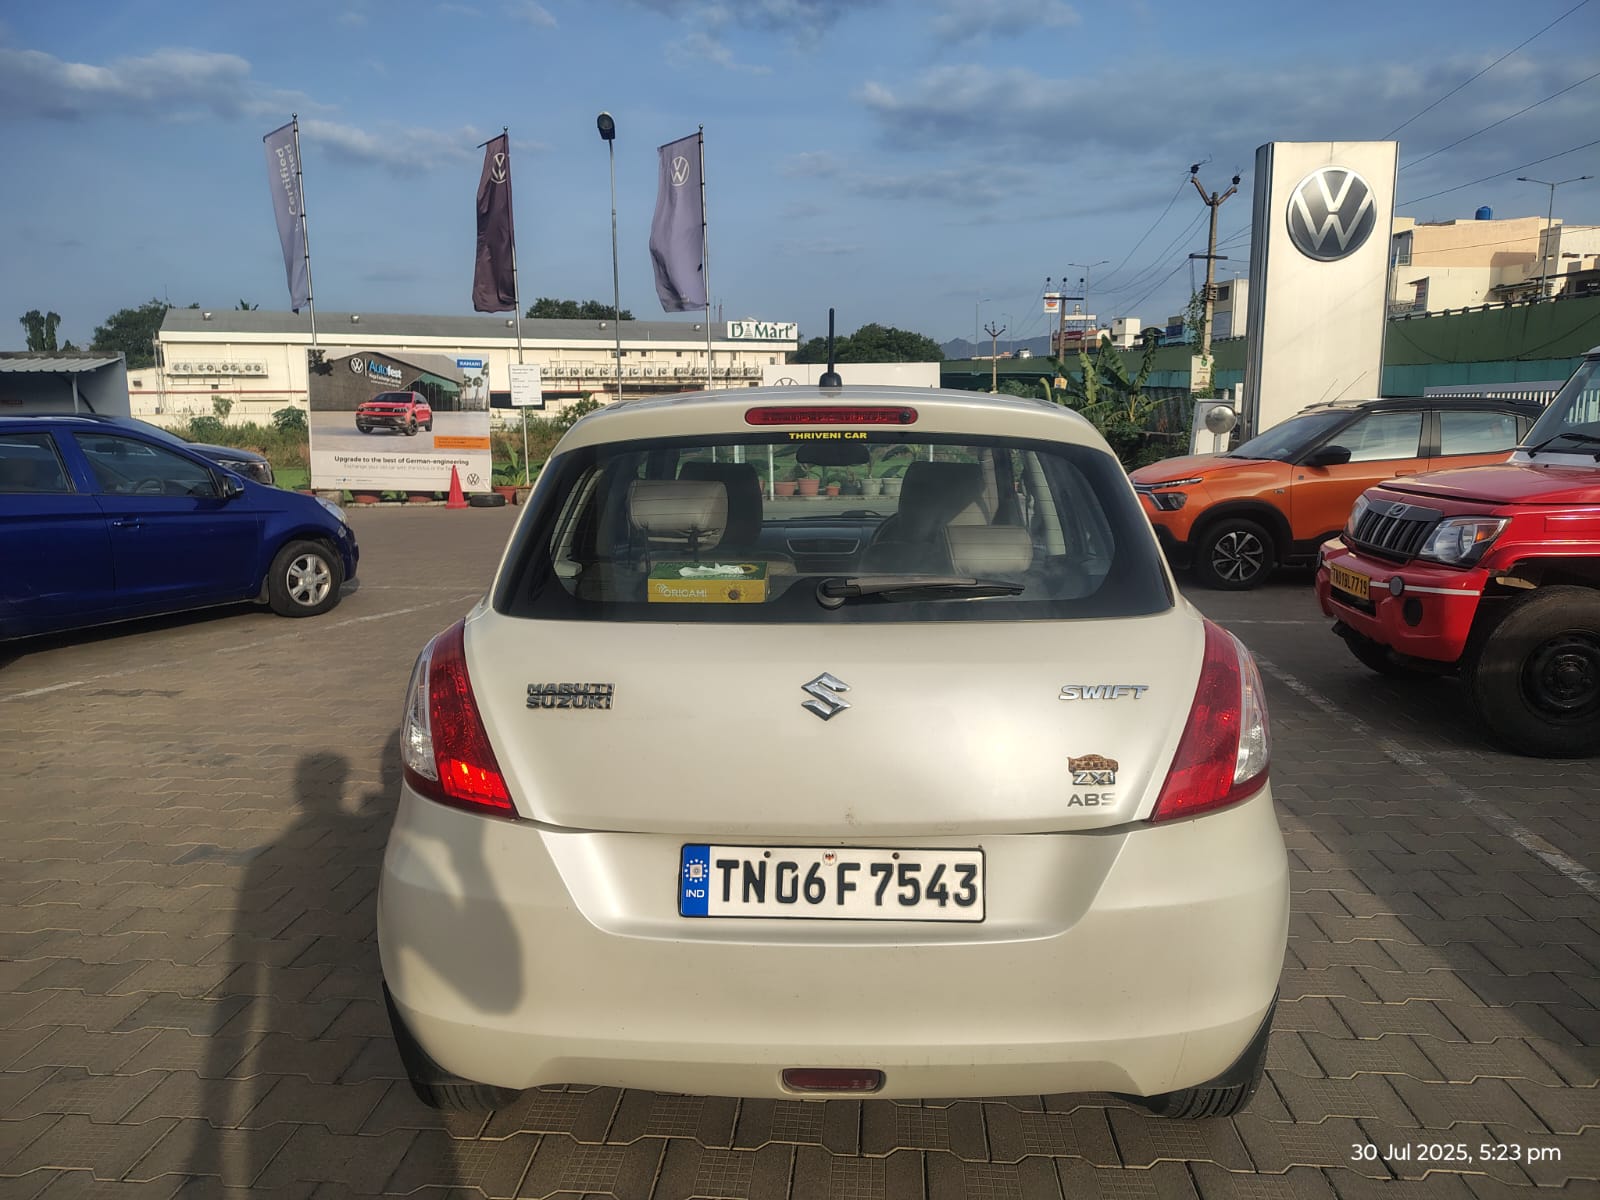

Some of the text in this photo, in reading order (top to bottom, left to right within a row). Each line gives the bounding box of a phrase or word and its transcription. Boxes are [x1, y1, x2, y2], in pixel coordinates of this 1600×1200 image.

[276, 147, 297, 215] Certified
[368, 360, 402, 379] Autofest
[788, 432, 841, 440] THRIVENI
[334, 455, 361, 463] Upgrade
[405, 458, 469, 466] German-engineering
[663, 588, 707, 598] ORIGAMI
[527, 683, 615, 695] MARUTI
[1059, 685, 1149, 701] SWIFT
[526, 695, 614, 710] SUZUKI
[1067, 792, 1116, 807] ABS
[685, 889, 705, 899] IND
